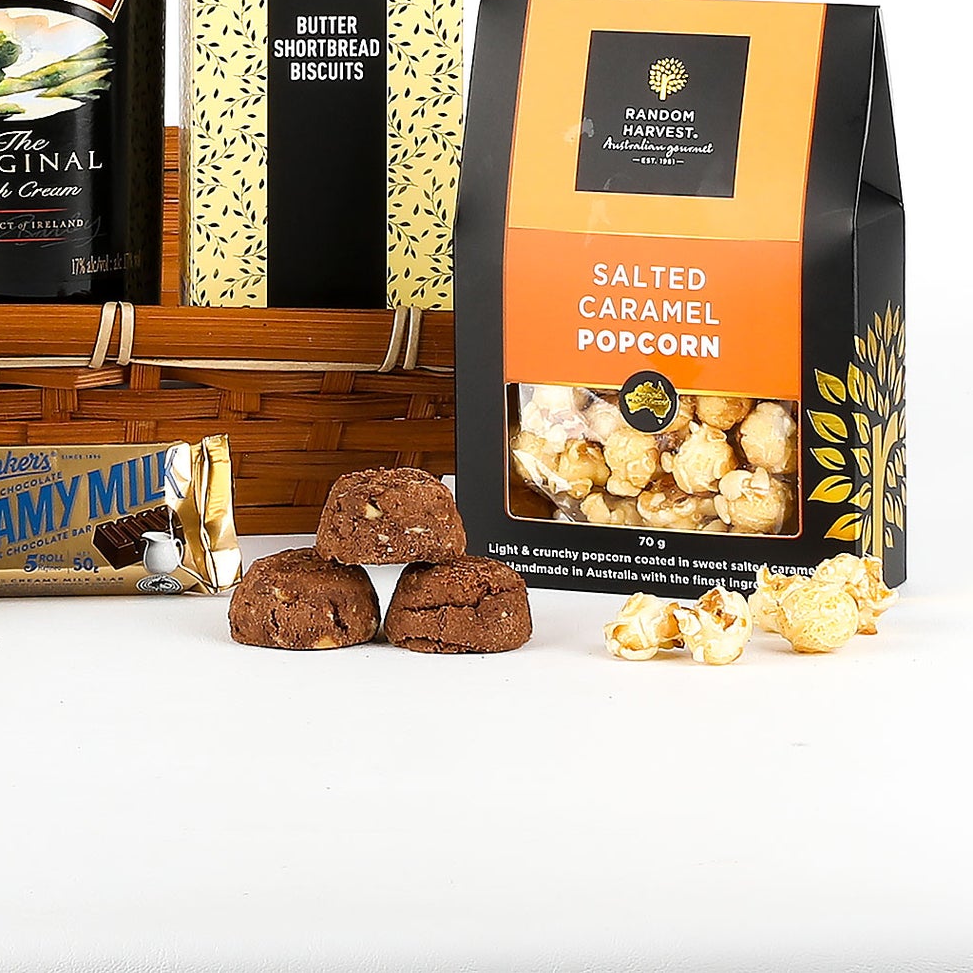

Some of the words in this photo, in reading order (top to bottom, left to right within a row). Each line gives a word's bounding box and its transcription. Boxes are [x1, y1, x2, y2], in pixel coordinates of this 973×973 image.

[296, 15, 357, 35] BUTTER
[273, 38, 380, 58] SHORTBREAD
[290, 61, 364, 81] BISCUITS
[625, 107, 695, 122] RANDOM
[602, 136, 666, 151] Australian
[666, 143, 714, 158] gourmet
[18, 181, 83, 199] Cream
[17, 220, 28, 232] of
[31, 219, 84, 230] IRELAND
[593, 263, 706, 291] SALTED
[578, 295, 720, 325] CARAMEL
[578, 328, 720, 358] POPCORN
[0, 471, 62, 496] CHOCOLATE
[6, 532, 68, 556] CHOCOLATE
[72, 524, 92, 537] BAR
[638, 536, 654, 547] 70
[657, 539, 666, 549] g
[39, 554, 64, 563] ROLL
[488, 542, 518, 555] Light
[521, 546, 529, 555] &
[532, 548, 579, 561] crunchy
[582, 551, 631, 564] popcorn
[634, 554, 675, 566] coated
[678, 557, 689, 568] in
[693, 560, 727, 571] sweet
[771, 564, 818, 576] carame
[507, 561, 569, 576] Handmade
[572, 565, 583, 577] in
[586, 568, 638, 581] Australia
[640, 572, 667, 583] with
[670, 573, 689, 584] the
[693, 575, 726, 587] finest
